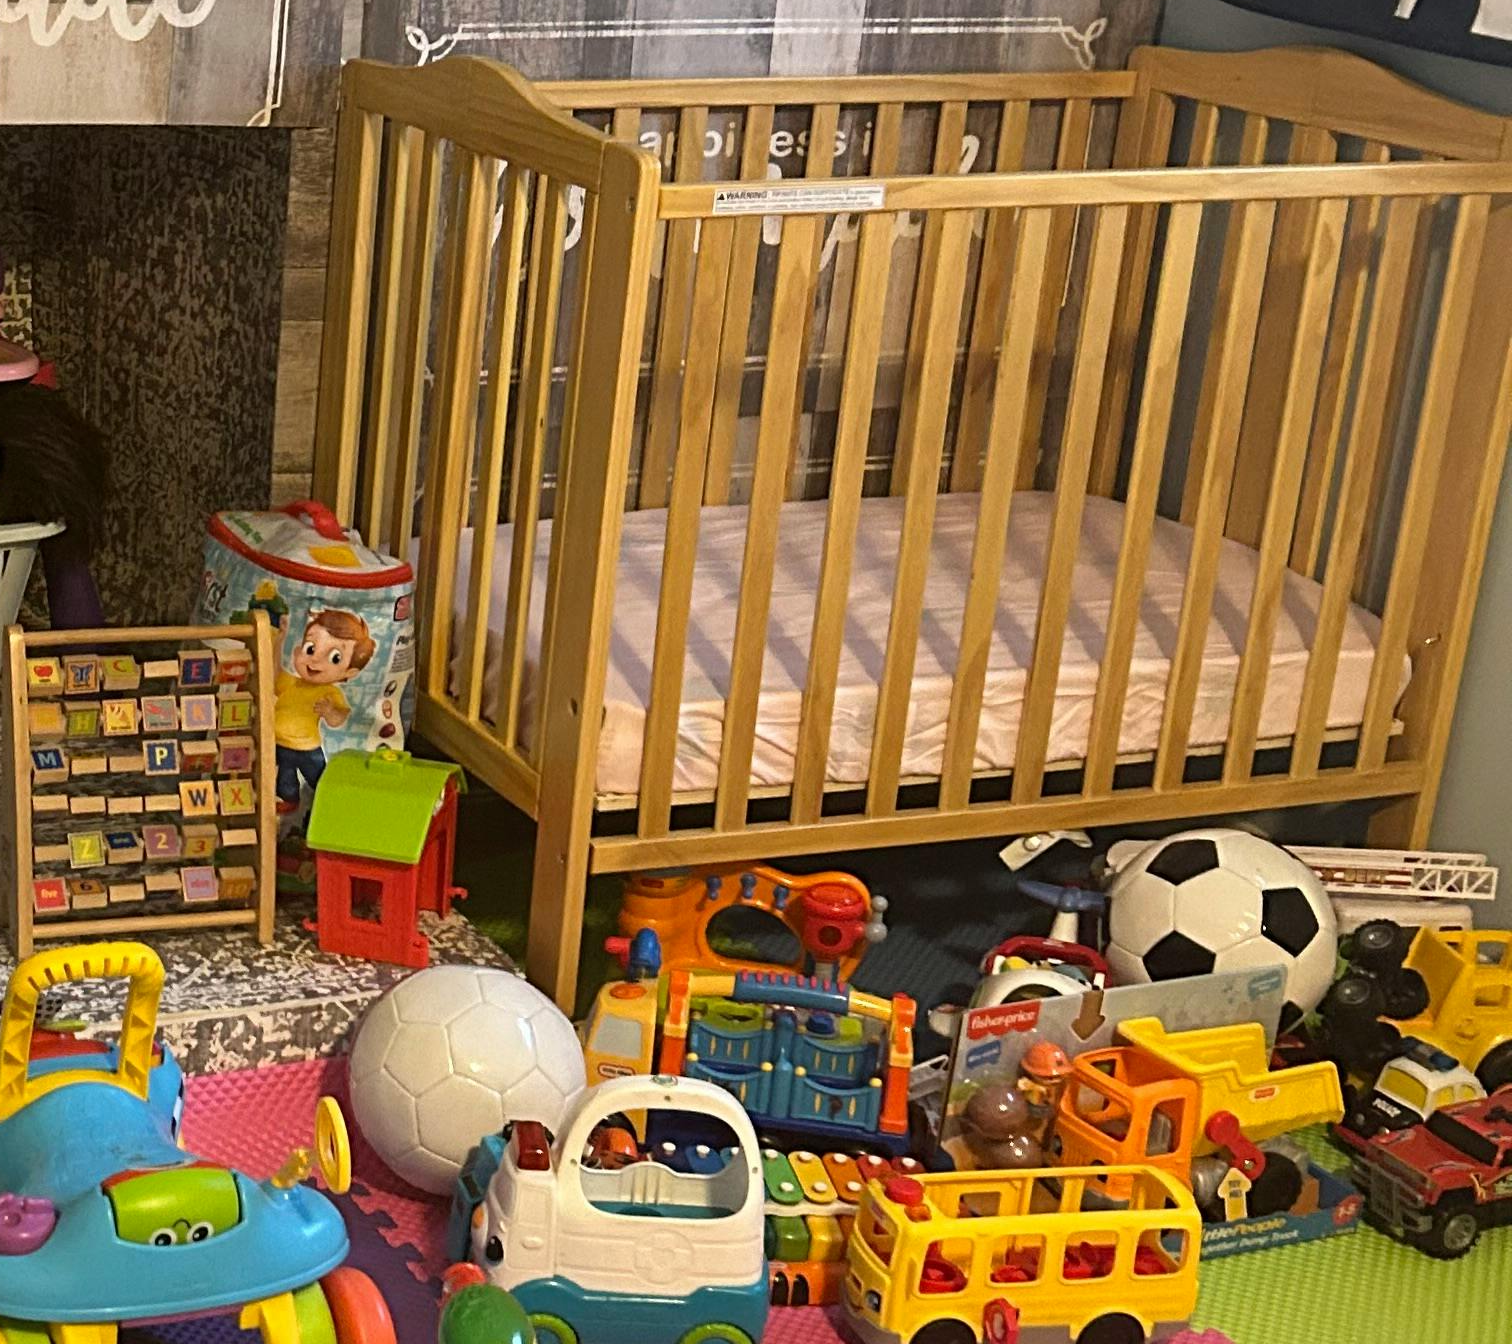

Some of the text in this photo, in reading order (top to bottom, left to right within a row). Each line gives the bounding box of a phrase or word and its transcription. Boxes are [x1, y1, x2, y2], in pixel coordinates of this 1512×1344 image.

[191, 661, 205, 679] E
[231, 705, 242, 723] L
[37, 751, 58, 767] M
[154, 746, 169, 767] P
[186, 787, 209, 808] W
[230, 786, 243, 807] X
[78, 839, 94, 860] Z
[154, 831, 169, 850] 2
[193, 839, 206, 854] 3
